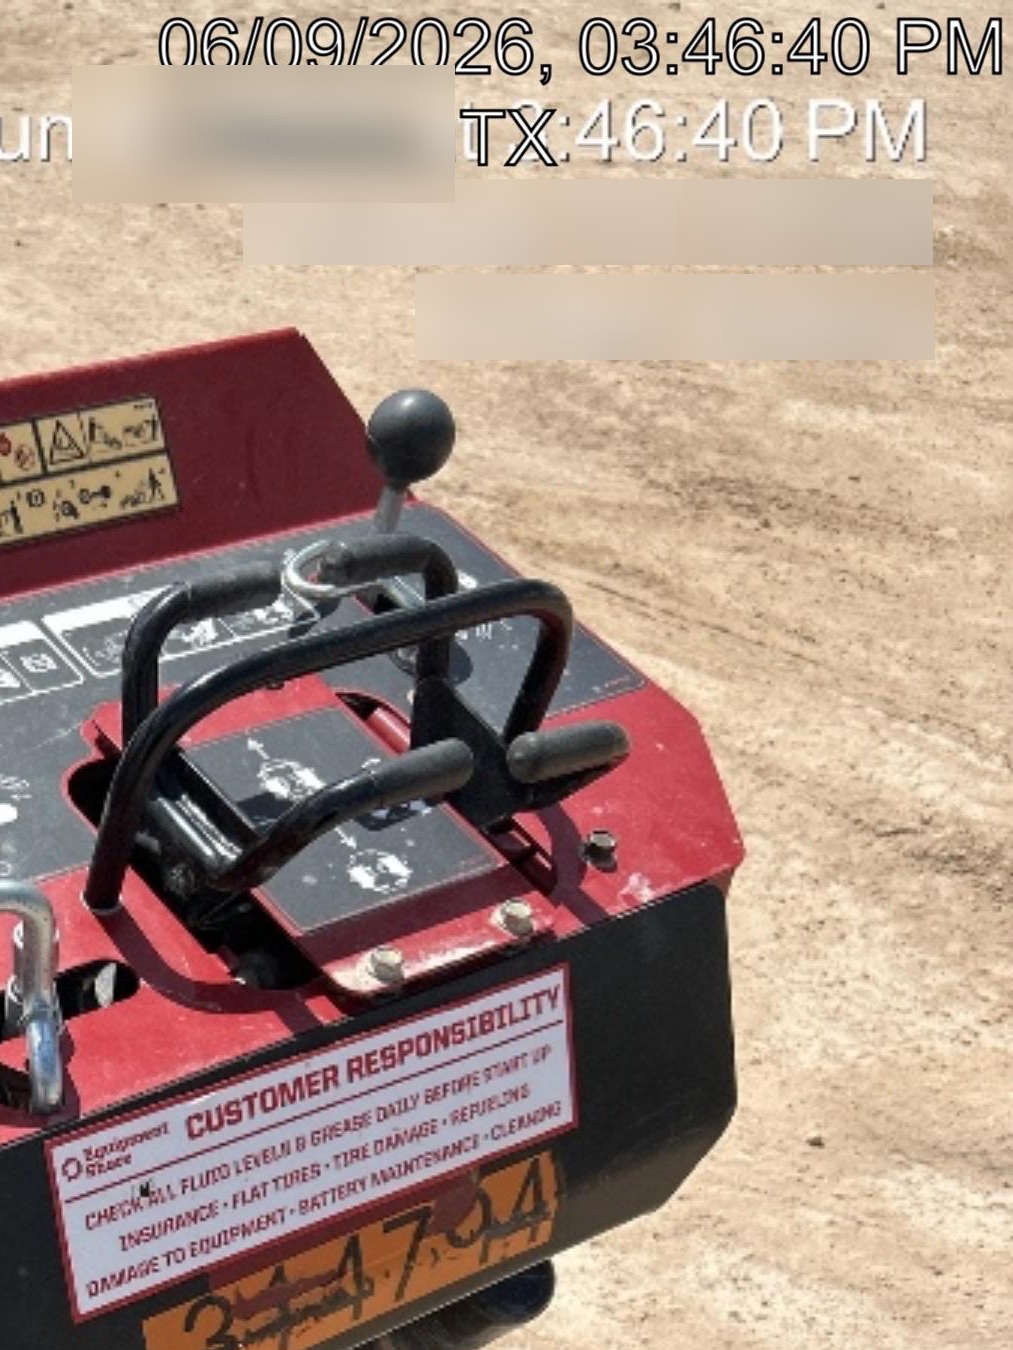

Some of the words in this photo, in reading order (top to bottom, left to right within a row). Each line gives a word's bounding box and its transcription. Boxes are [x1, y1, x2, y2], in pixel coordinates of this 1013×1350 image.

[82, 1119, 169, 1164] Equipment
[84, 1194, 142, 1231] CHECK
[147, 1182, 175, 1208] ALL
[180, 1161, 230, 1196] FLUID
[234, 1138, 292, 1176] LEVELS
[309, 1109, 372, 1147] GREASE
[376, 1091, 419, 1123] DAILY
[424, 1069, 480, 1105] BEFORE
[483, 1051, 528, 1083] START
[531, 1043, 551, 1065] UP
[184, 1062, 340, 1142] CUSTOMER
[346, 984, 560, 1085] RESPONSIBILITY
[86, 1255, 160, 1300] DAMAGE
[164, 1245, 186, 1270] TO
[189, 1206, 285, 1260] EQUIPMENT
[298, 1174, 367, 1217] BATTERY
[369, 1130, 480, 1189] MAINTENANCE
[490, 1099, 561, 1142] CLEANING
[118, 1198, 220, 1253] INSURANCE
[230, 1179, 268, 1210] FLAT
[271, 1159, 321, 1194] TIRES
[332, 1141, 370, 1171] TIRE
[372, 1115, 438, 1156] DAMAGE
[450, 1080, 531, 1126] REFUELING
